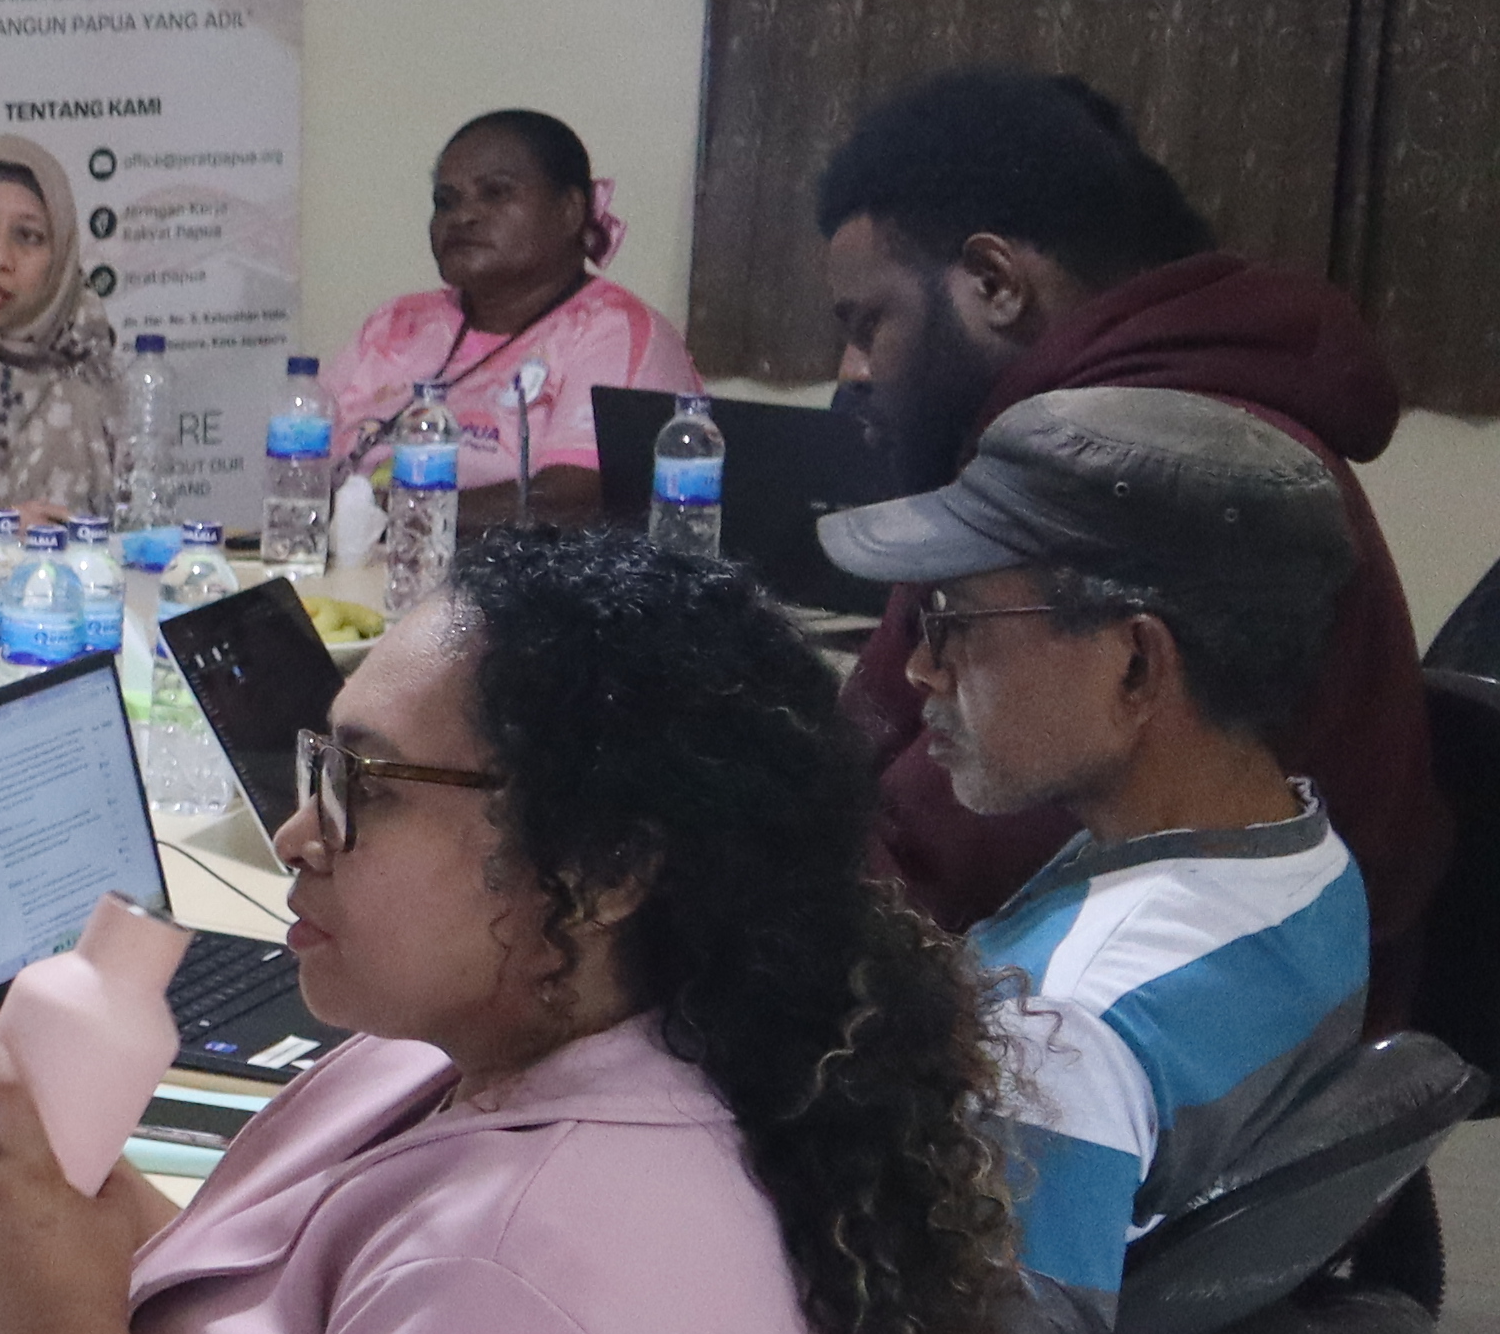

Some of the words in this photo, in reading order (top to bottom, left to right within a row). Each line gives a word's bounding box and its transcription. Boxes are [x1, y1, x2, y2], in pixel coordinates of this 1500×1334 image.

[71, 14, 137, 34] PAPUA
[142, 12, 198, 31] YANG
[5, 100, 104, 121] TENTANG
[108, 98, 162, 117] KAMI
